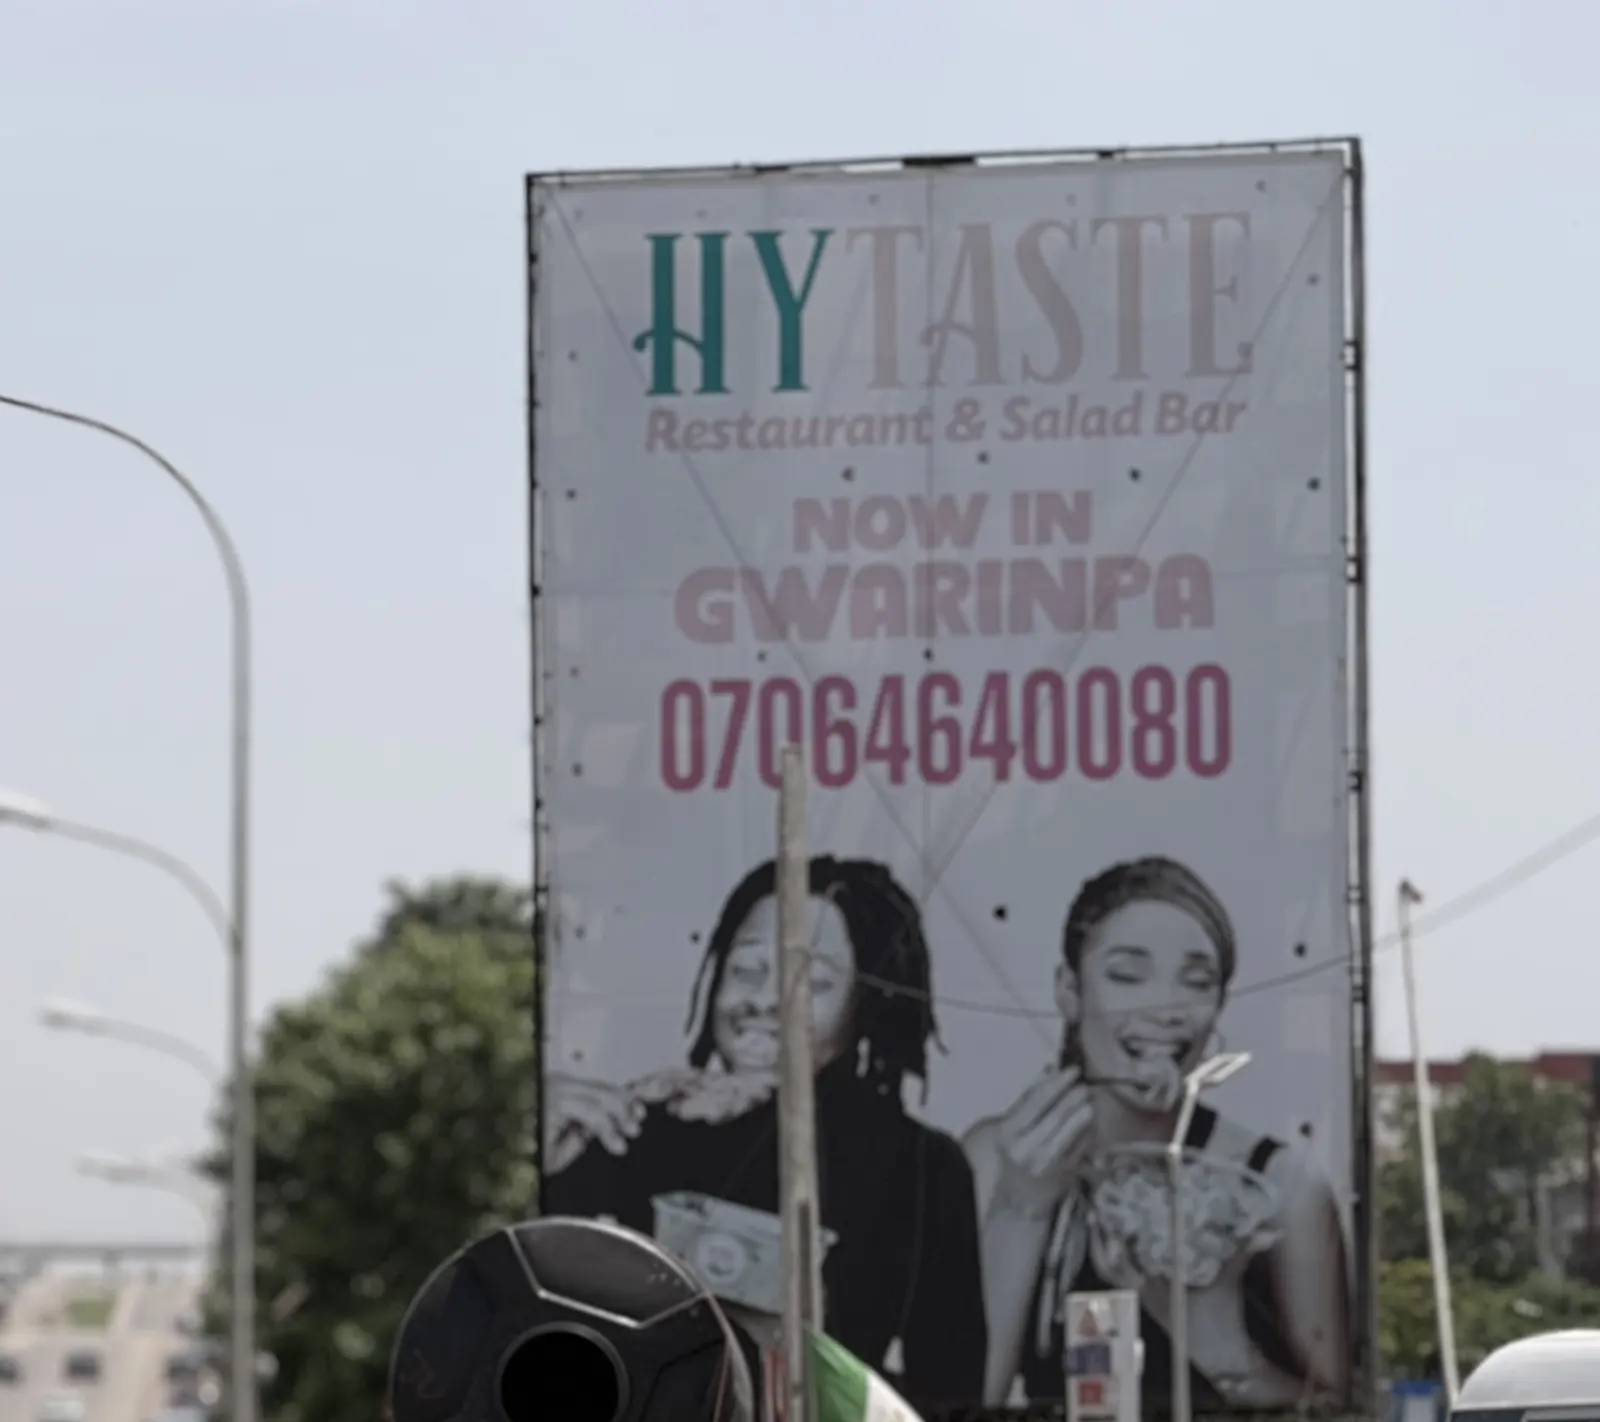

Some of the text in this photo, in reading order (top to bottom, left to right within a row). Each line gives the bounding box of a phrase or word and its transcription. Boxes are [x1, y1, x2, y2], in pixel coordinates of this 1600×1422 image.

[645, 389, 1248, 454] Restaurant & Salad Bar
[792, 489, 1092, 553] NOW IN
[674, 553, 1214, 644] GWARINPA
[660, 661, 1231, 793] 07064640080
